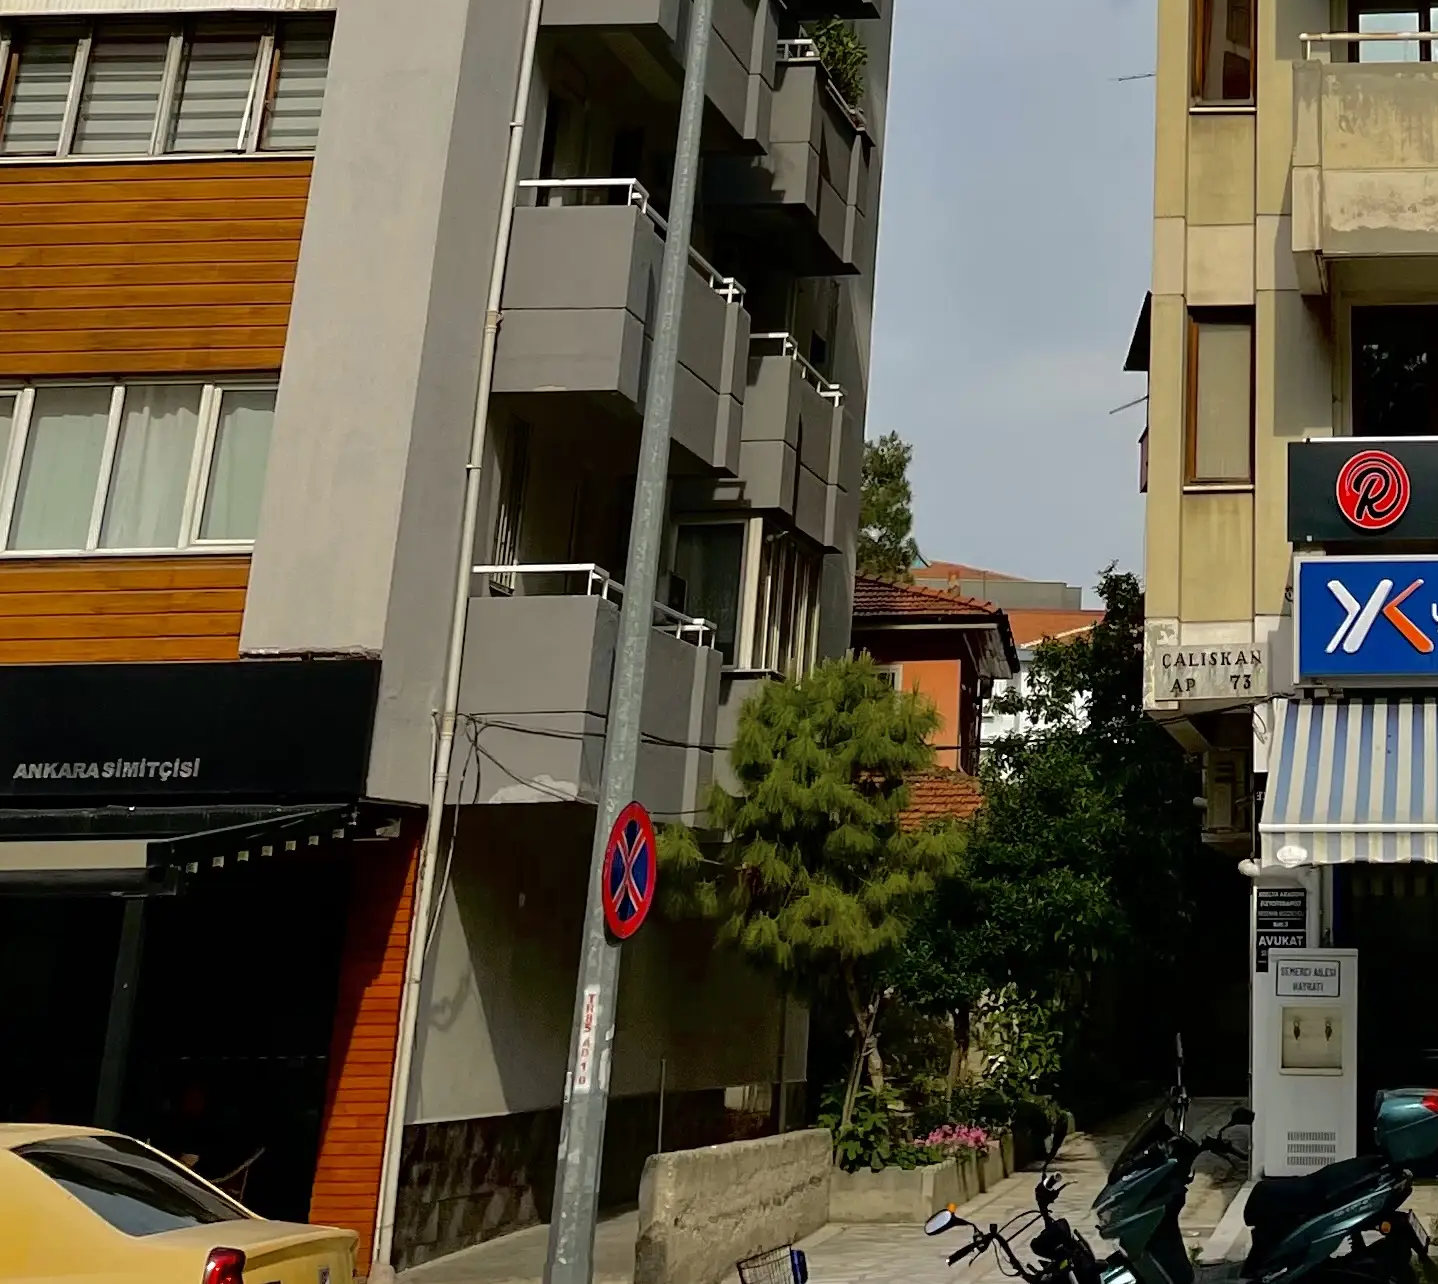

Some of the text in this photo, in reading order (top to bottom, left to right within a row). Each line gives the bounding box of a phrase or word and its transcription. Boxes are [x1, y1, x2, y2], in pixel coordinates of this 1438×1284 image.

[1170, 674, 1252, 693] AP 73
[13, 757, 201, 782] ANKARA SİMİTÇİSİ
[1258, 935, 1304, 946] AVUKAT
